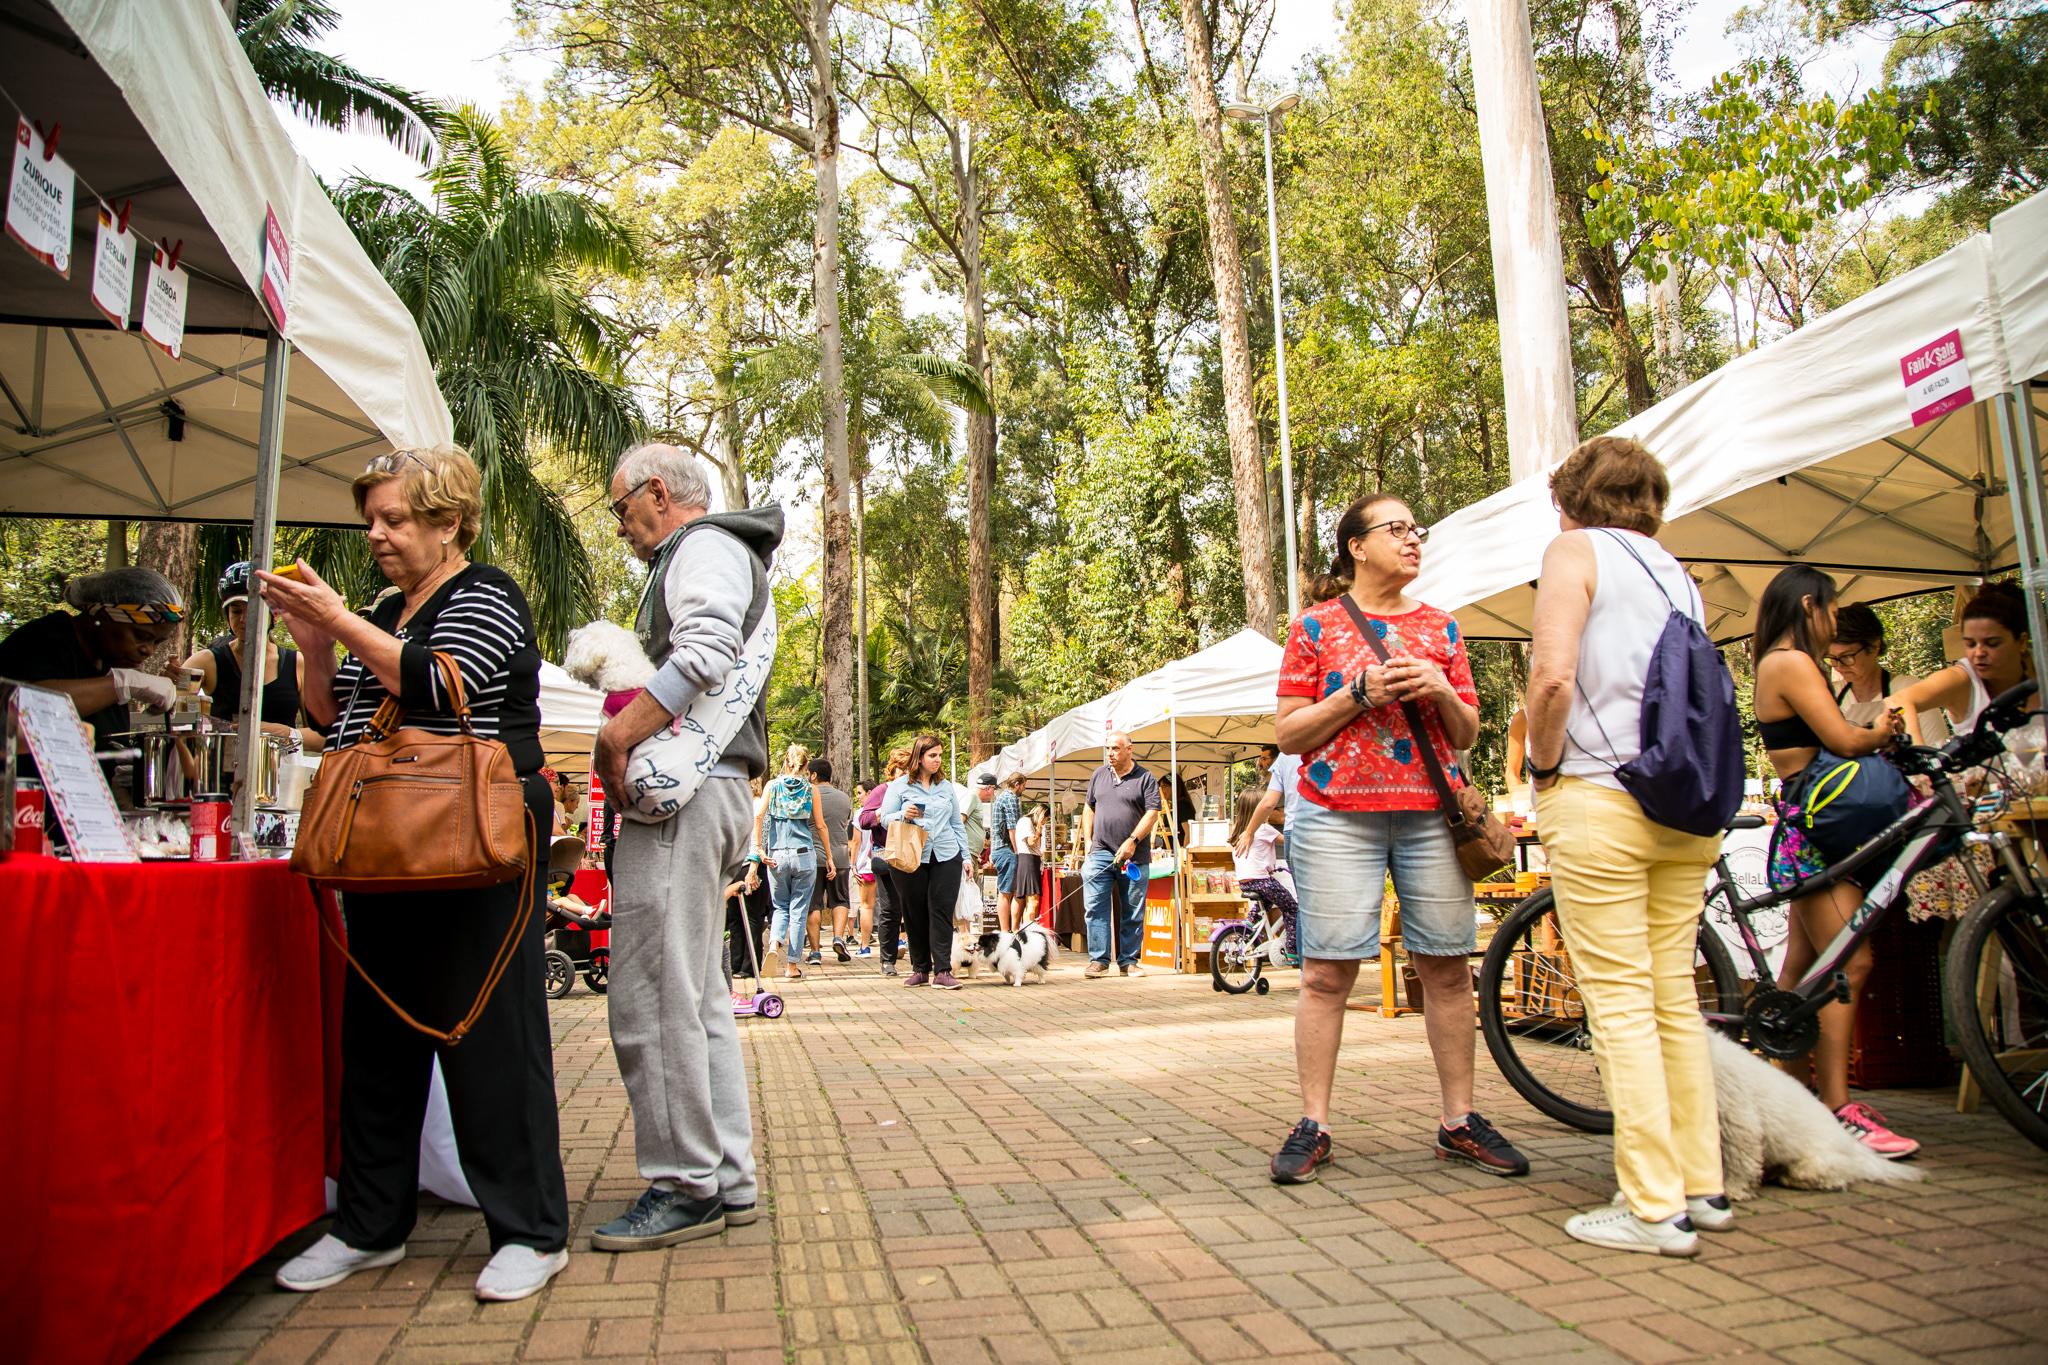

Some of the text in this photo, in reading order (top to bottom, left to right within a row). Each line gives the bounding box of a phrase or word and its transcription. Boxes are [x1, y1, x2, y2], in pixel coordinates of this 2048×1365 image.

[15, 183, 34, 209] QUEIJO
[21, 174, 40, 198] BATATA
[39, 192, 57, 212] FRITA
[23, 156, 63, 205] ZURIQUE
[12, 192, 67, 246] MOLHO DE QUEIJOS
[105, 236, 127, 270] BERLIM
[156, 275, 177, 304] LISBOA
